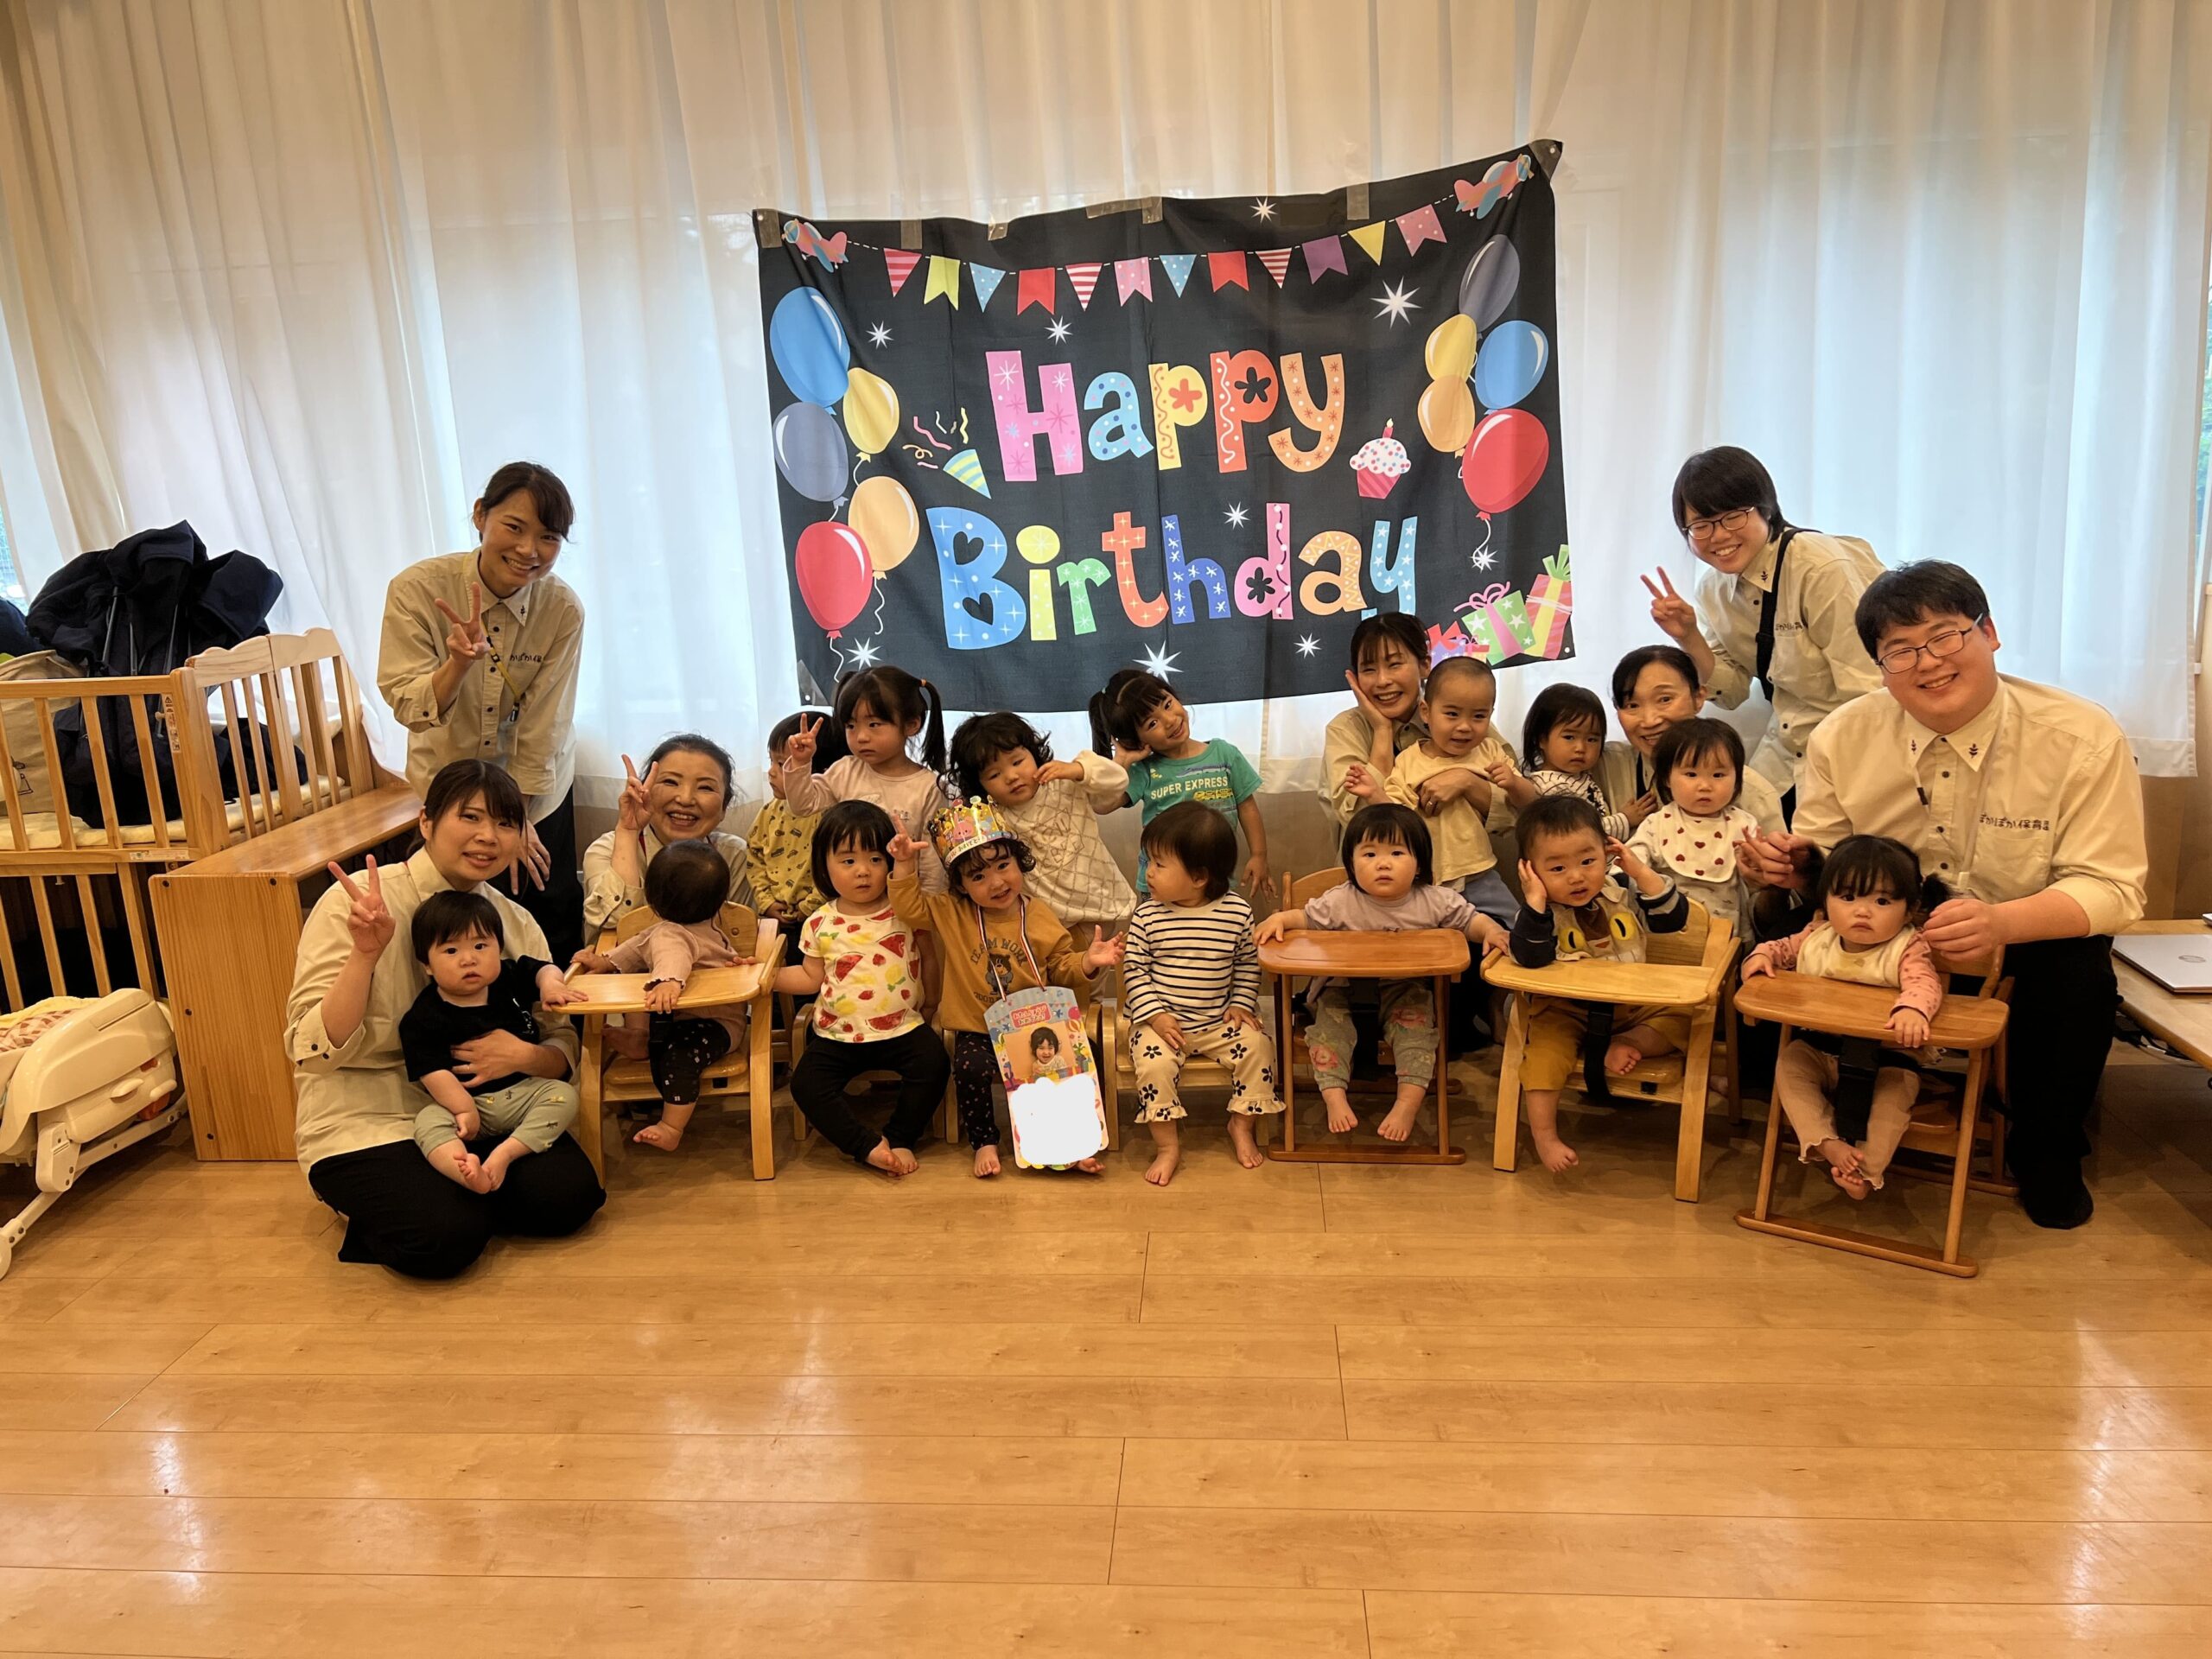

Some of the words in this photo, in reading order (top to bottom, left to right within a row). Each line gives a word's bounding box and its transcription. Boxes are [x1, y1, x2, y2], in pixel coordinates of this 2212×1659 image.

[985, 348, 1345, 482] Happy
[925, 502, 1418, 650] Birthday
[1150, 782, 1182, 800] SUPER
[1185, 776, 1228, 791] EXPRESS
